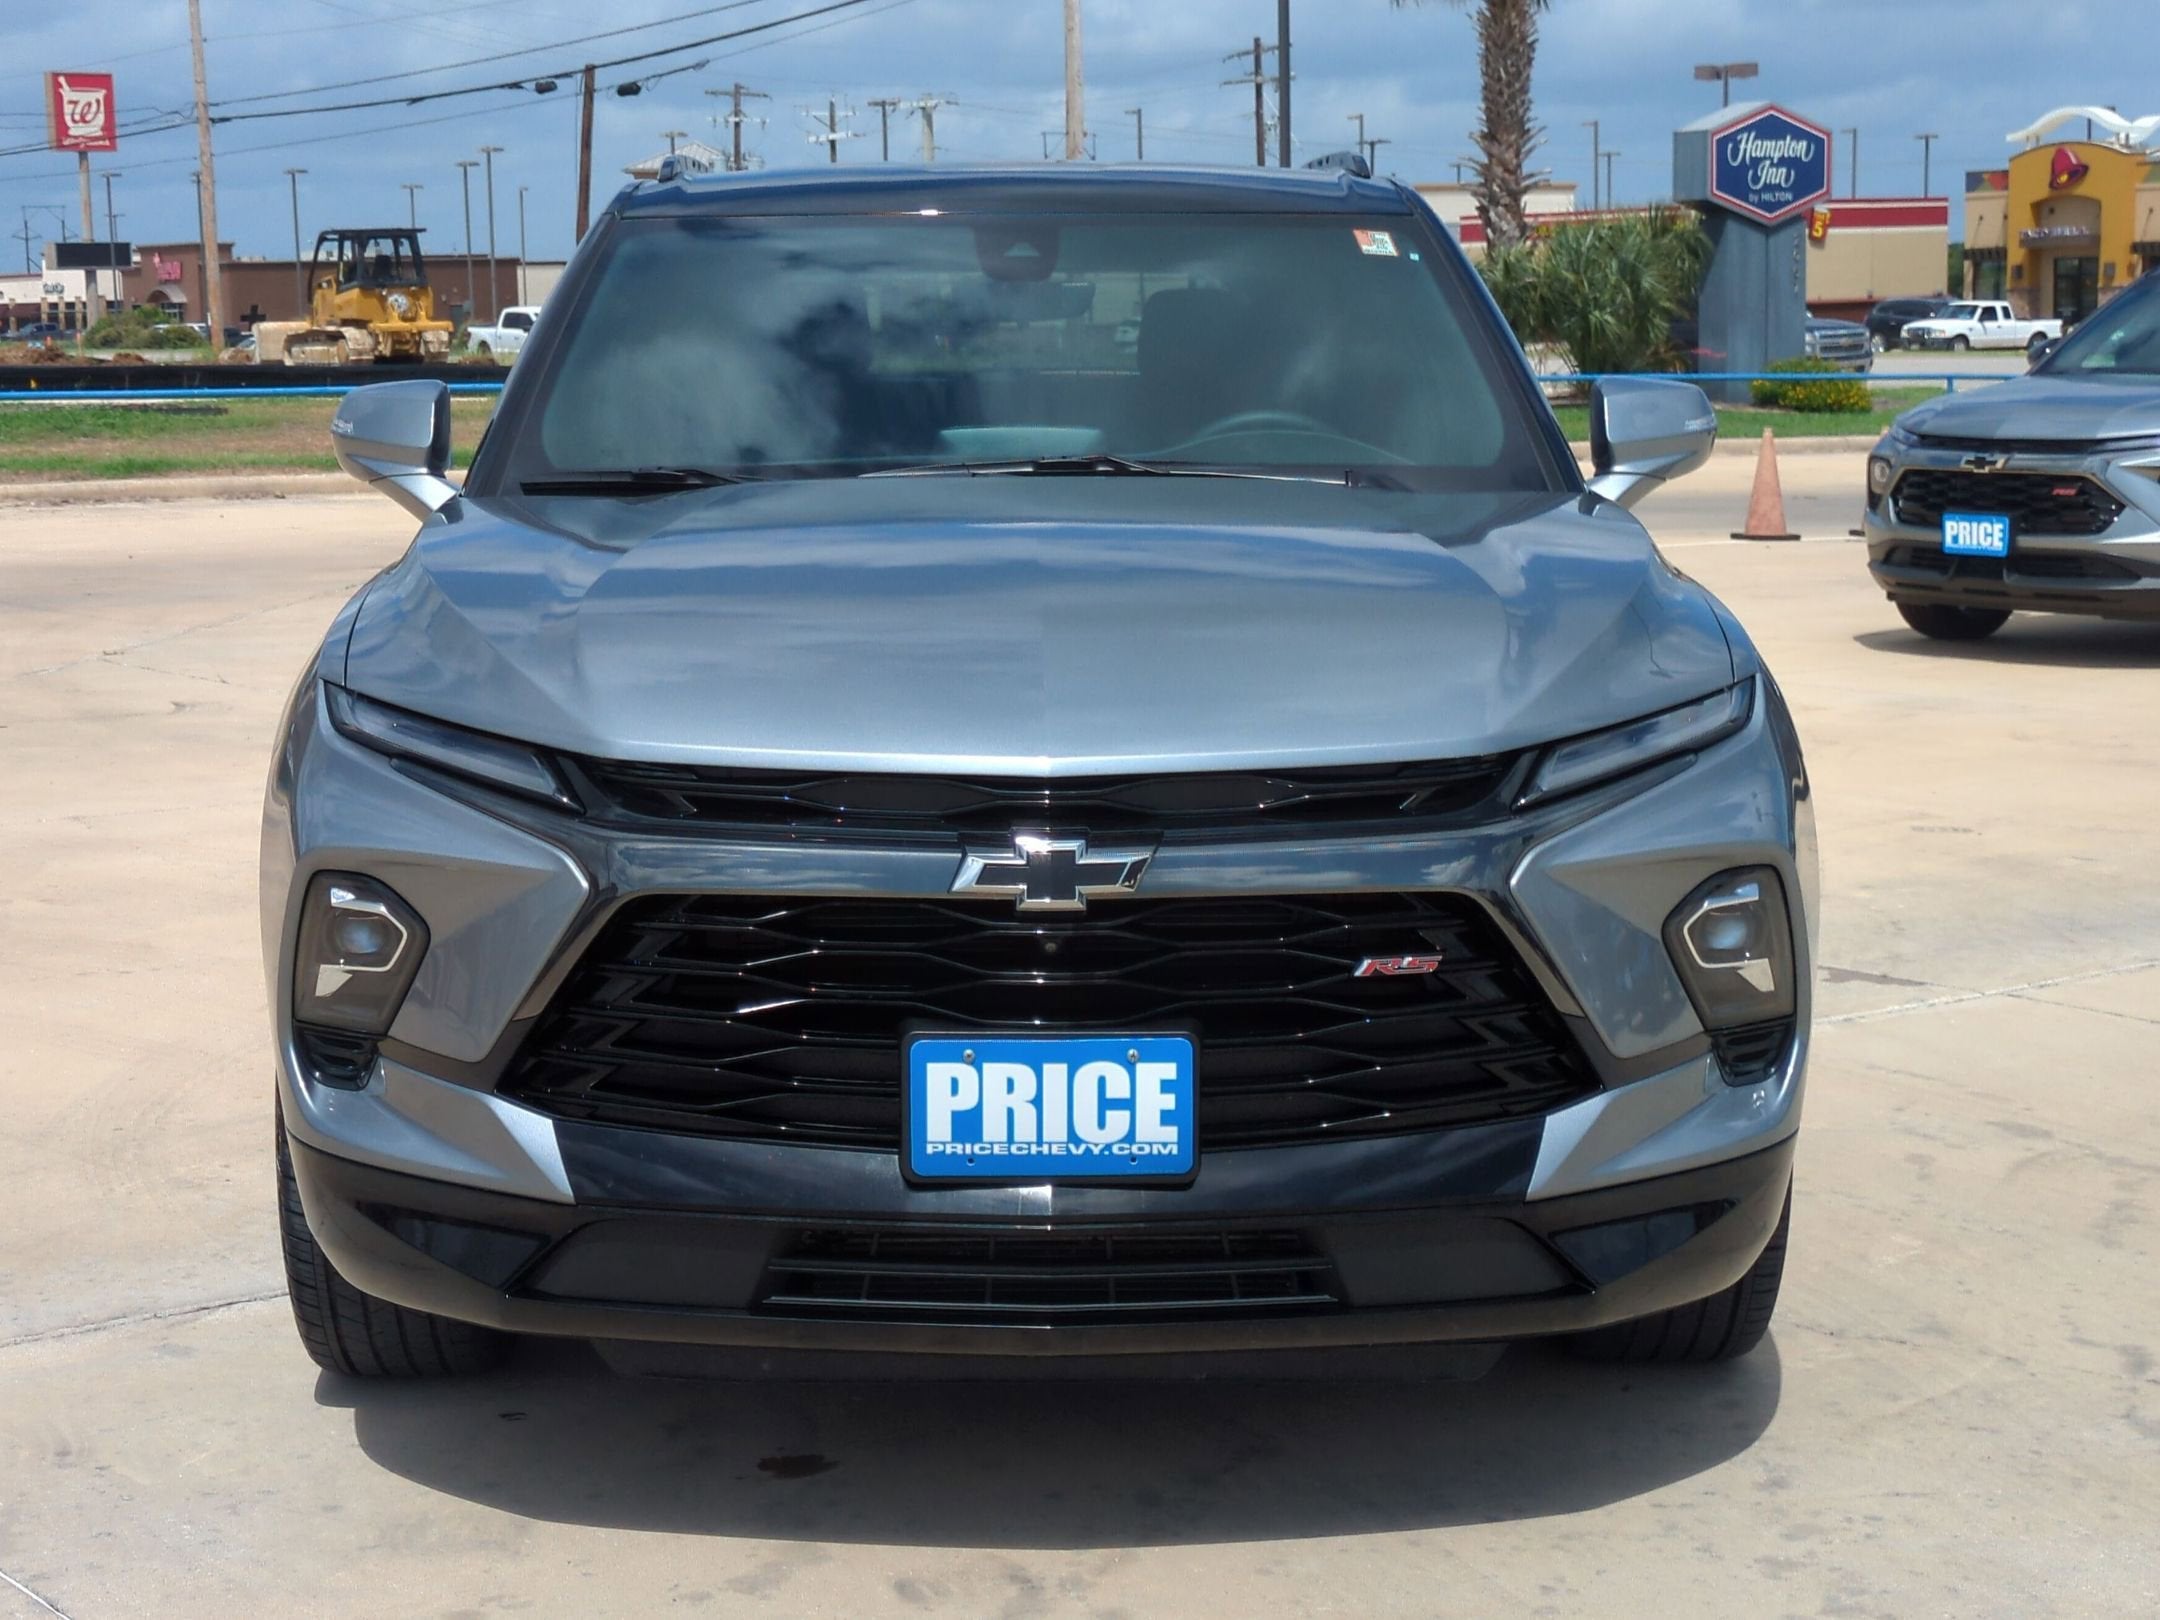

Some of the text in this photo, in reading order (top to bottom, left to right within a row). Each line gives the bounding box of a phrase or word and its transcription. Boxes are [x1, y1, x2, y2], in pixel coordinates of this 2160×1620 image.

[1727, 131, 1815, 166] Hampton
[1747, 159, 1795, 190] Inn
[1761, 192, 1793, 202] HILTON
[1945, 520, 2004, 548] PRICE
[1354, 955, 1442, 977] RS
[926, 1061, 1179, 1144] PRICE
[926, 1142, 1179, 1156] PRICECHEVY.COM
